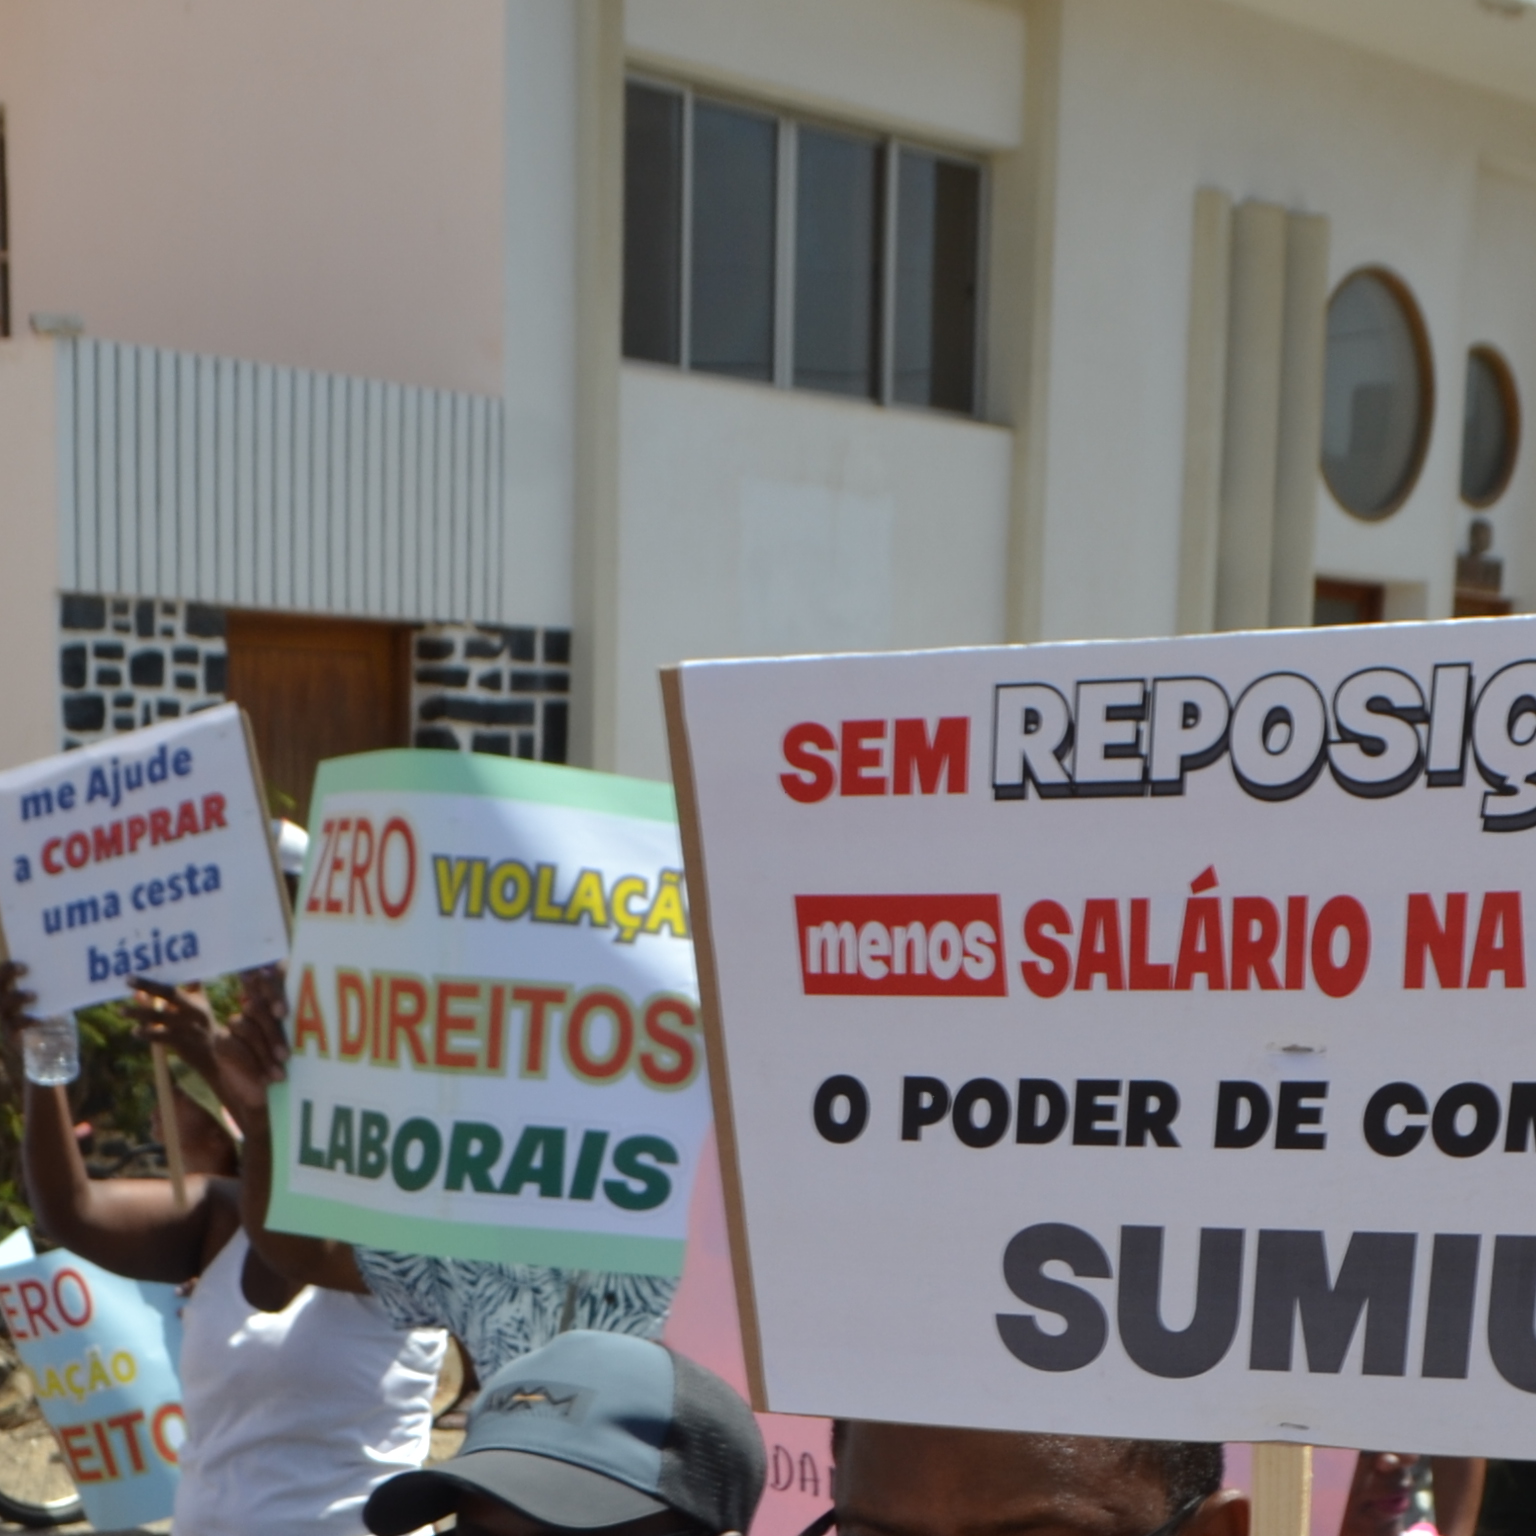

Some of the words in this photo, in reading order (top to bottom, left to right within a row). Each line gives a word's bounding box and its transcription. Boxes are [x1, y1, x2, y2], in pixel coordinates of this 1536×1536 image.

[20, 782, 75, 821] me
[86, 745, 192, 807] Ajude
[780, 717, 970, 803] SEM
[14, 855, 31, 883] a
[41, 792, 228, 875] COMPRAR
[305, 816, 416, 919] ZERO
[432, 853, 690, 944] VIOLAÇÃ
[42, 892, 121, 935] uma
[131, 864, 221, 912] cesta
[806, 919, 998, 981] menos
[1020, 865, 1371, 998] SALÁRIO
[1404, 892, 1526, 990] NA
[88, 929, 199, 983] básica
[292, 963, 331, 1058] A
[334, 968, 700, 1091] DIREITOS
[298, 1100, 678, 1211] LABORAIS
[813, 1075, 869, 1143] O
[901, 1076, 1181, 1148] PODER
[1213, 1080, 1329, 1150] DE
[54, 1403, 187, 1484] EITO
